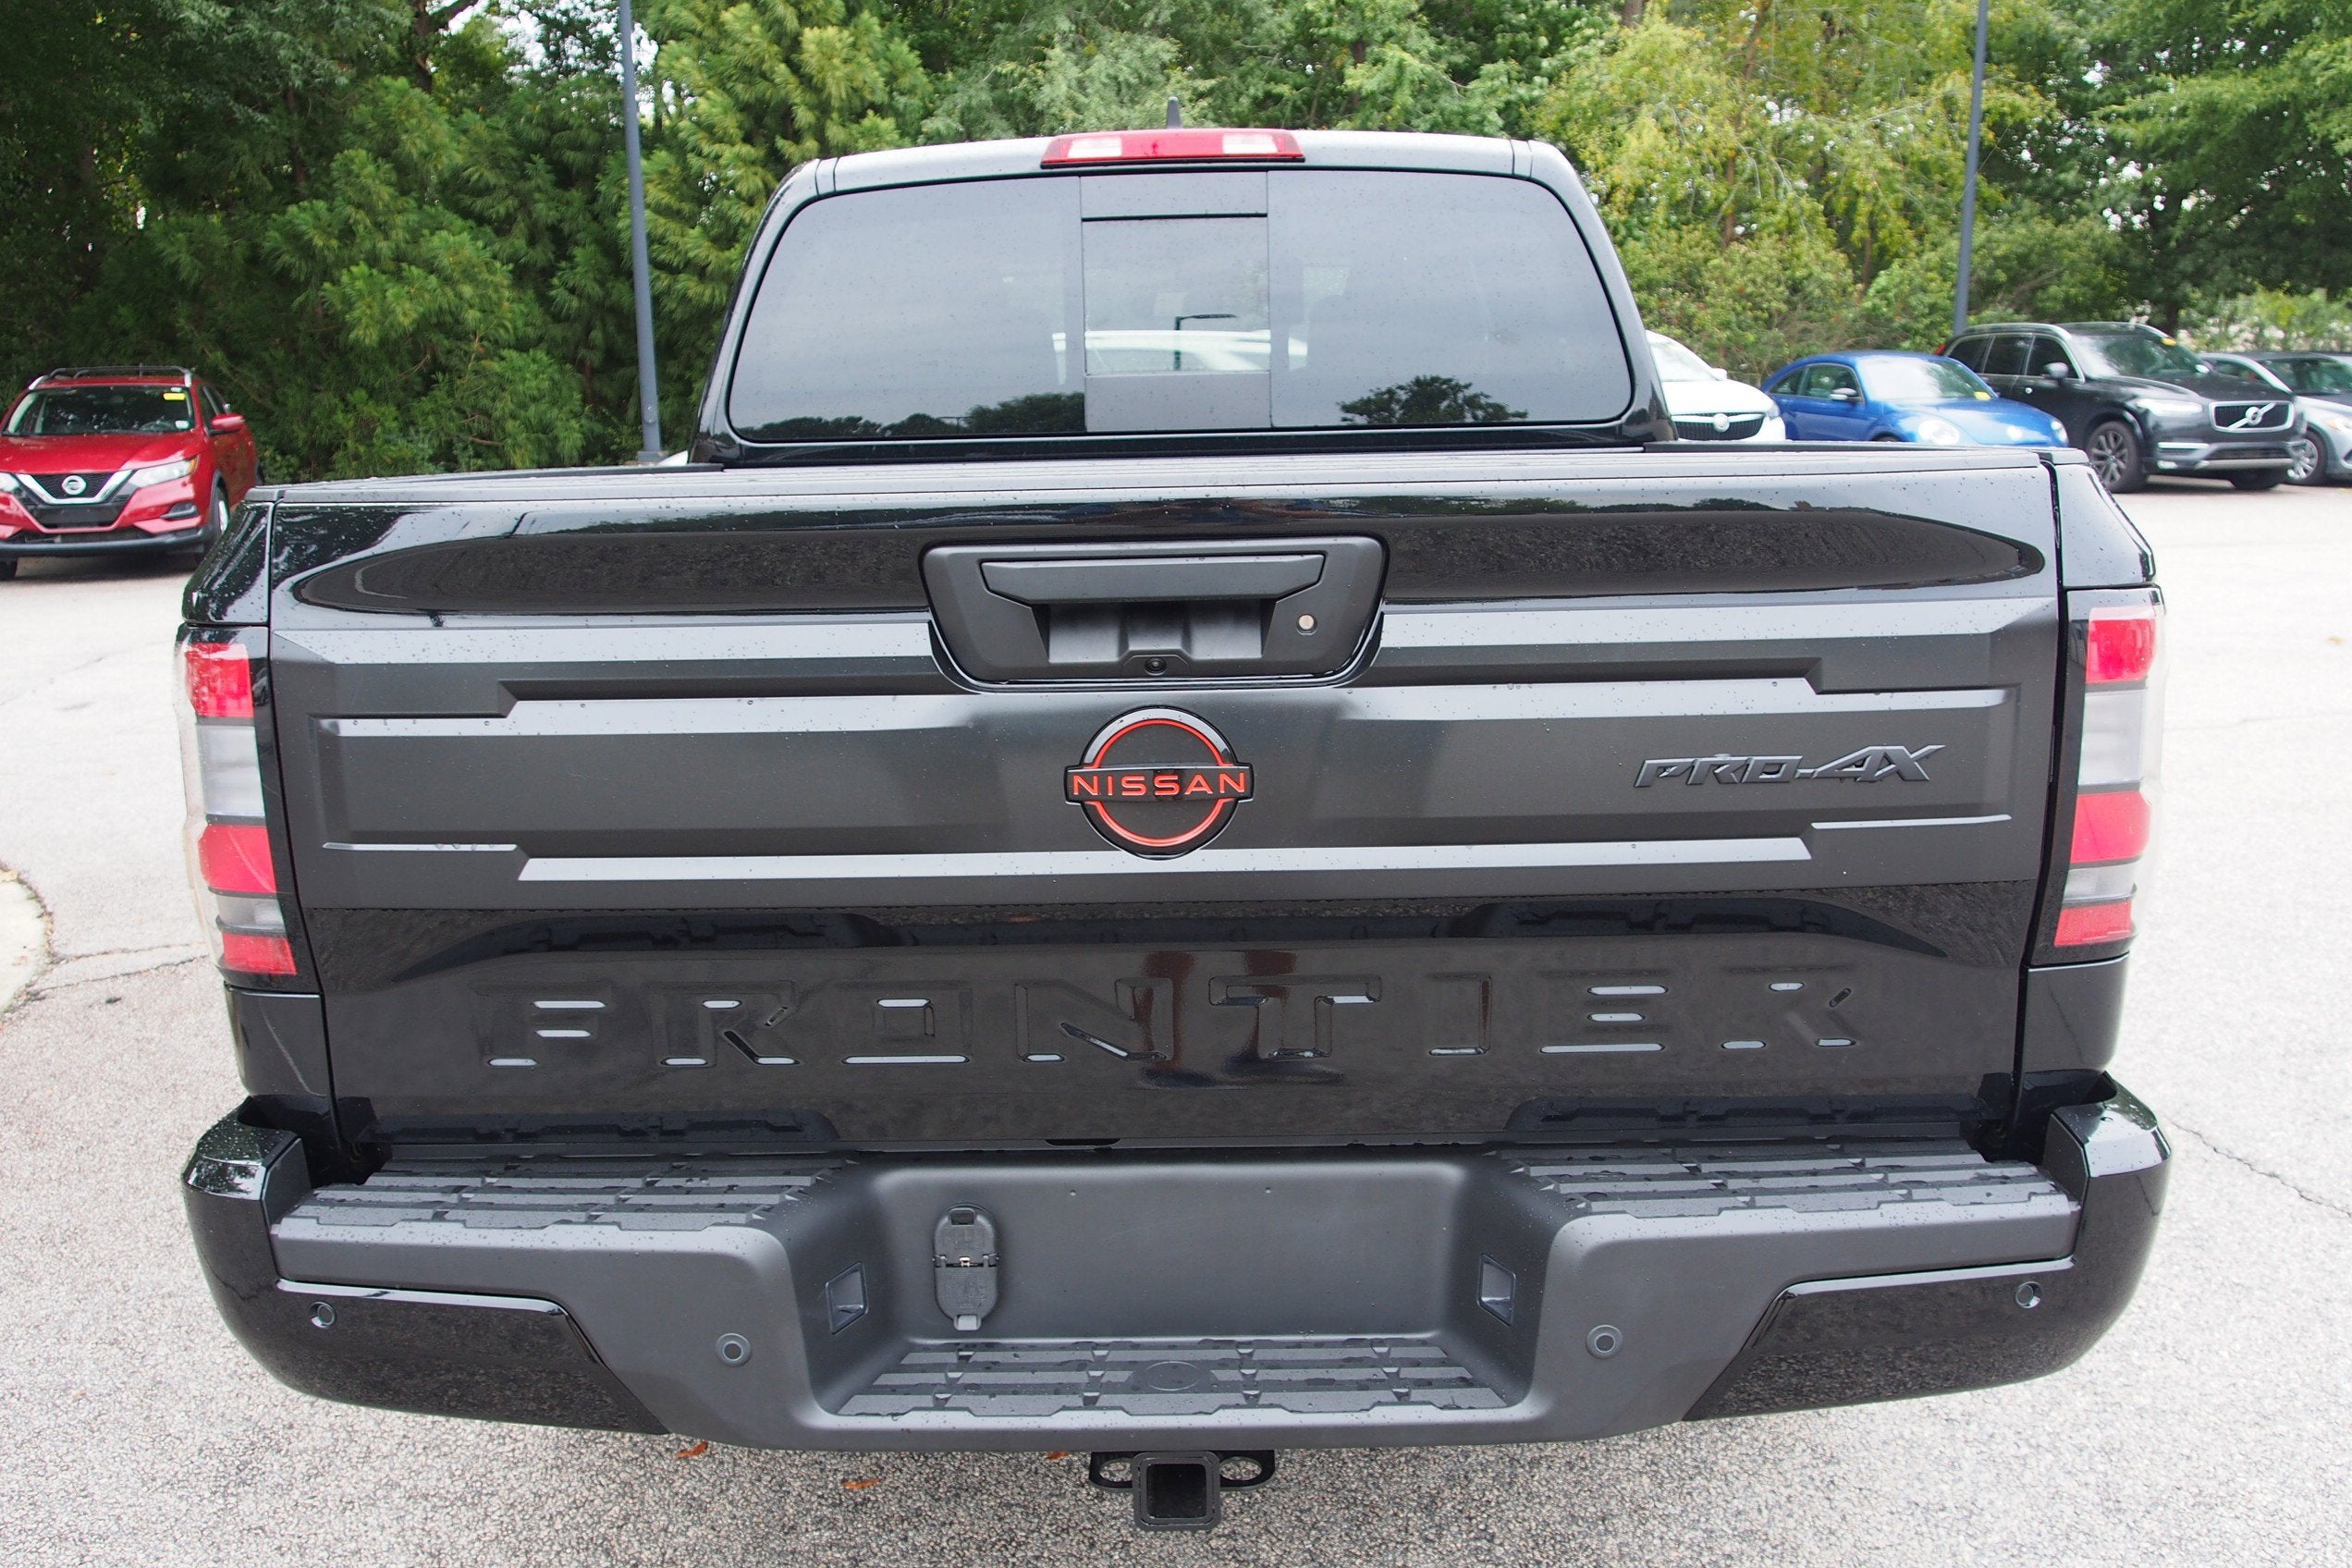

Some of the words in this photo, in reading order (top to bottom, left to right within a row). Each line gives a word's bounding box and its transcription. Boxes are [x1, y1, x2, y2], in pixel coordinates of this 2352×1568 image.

[1072, 772, 1246, 796] NISSAN
[1633, 744, 1946, 789] PRO-4X
[472, 964, 1858, 1068] FRONTIER
